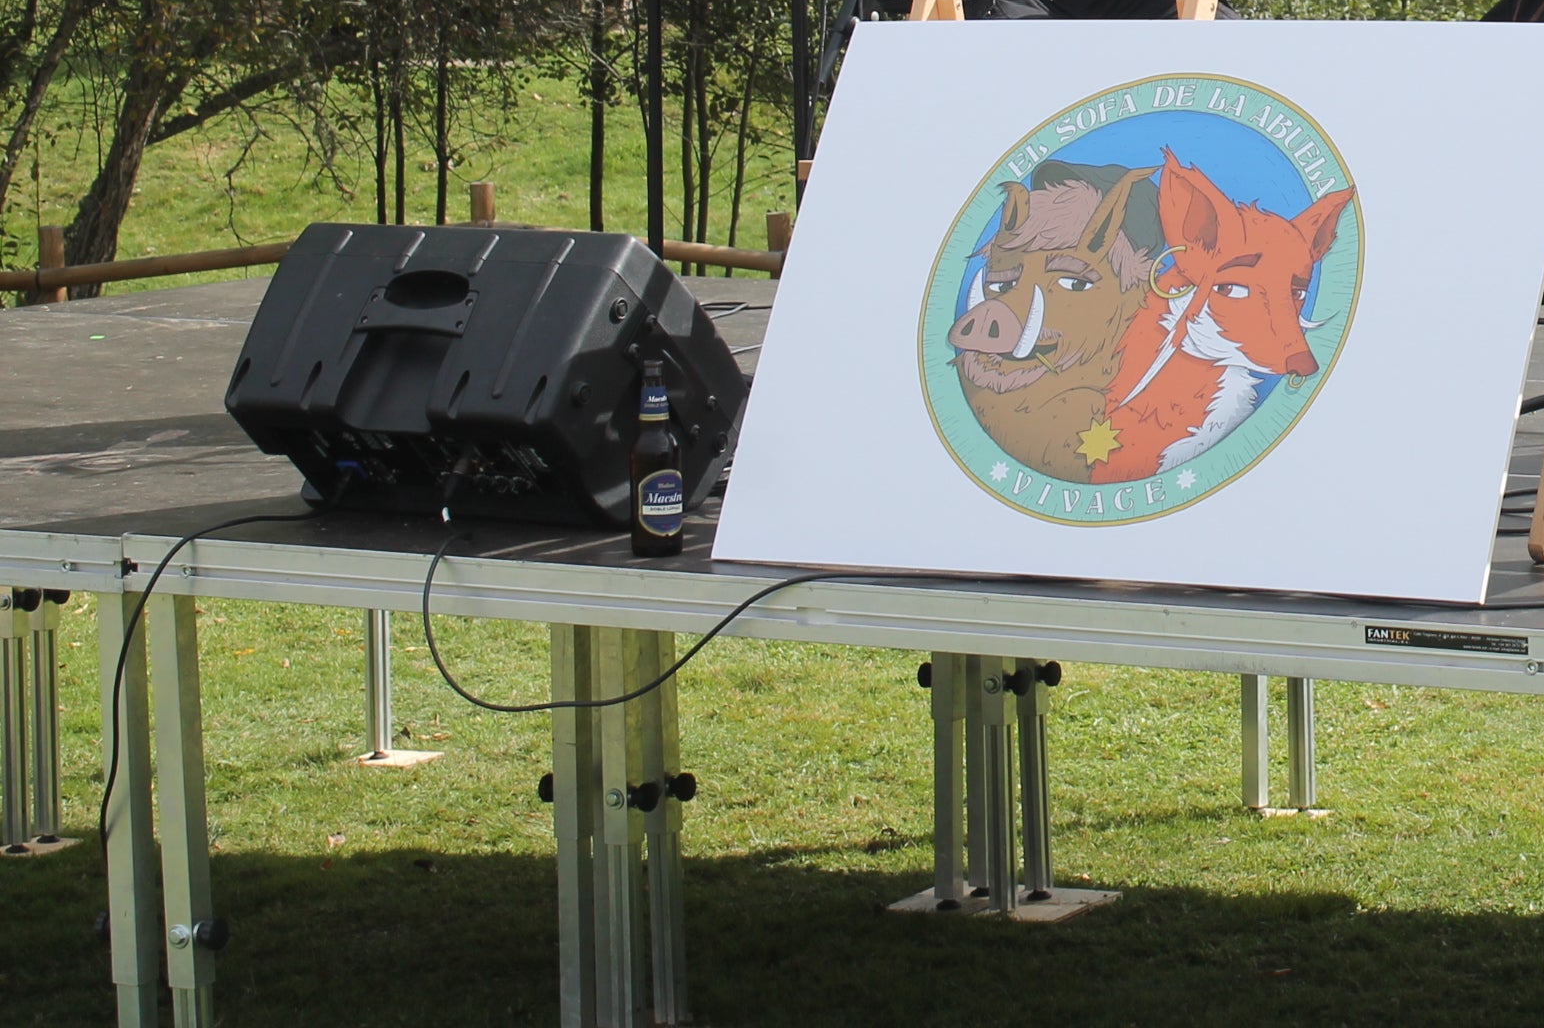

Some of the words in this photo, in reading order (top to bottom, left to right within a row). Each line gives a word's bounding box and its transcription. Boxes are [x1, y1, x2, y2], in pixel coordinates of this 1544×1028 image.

[1007, 143, 1049, 178] EL
[1152, 84, 1197, 108] DE
[1207, 87, 1247, 118] LA
[1249, 104, 1337, 199] ABUELA
[1012, 470, 1166, 514] VIVACE
[1367, 628, 1410, 641] FANTEK
